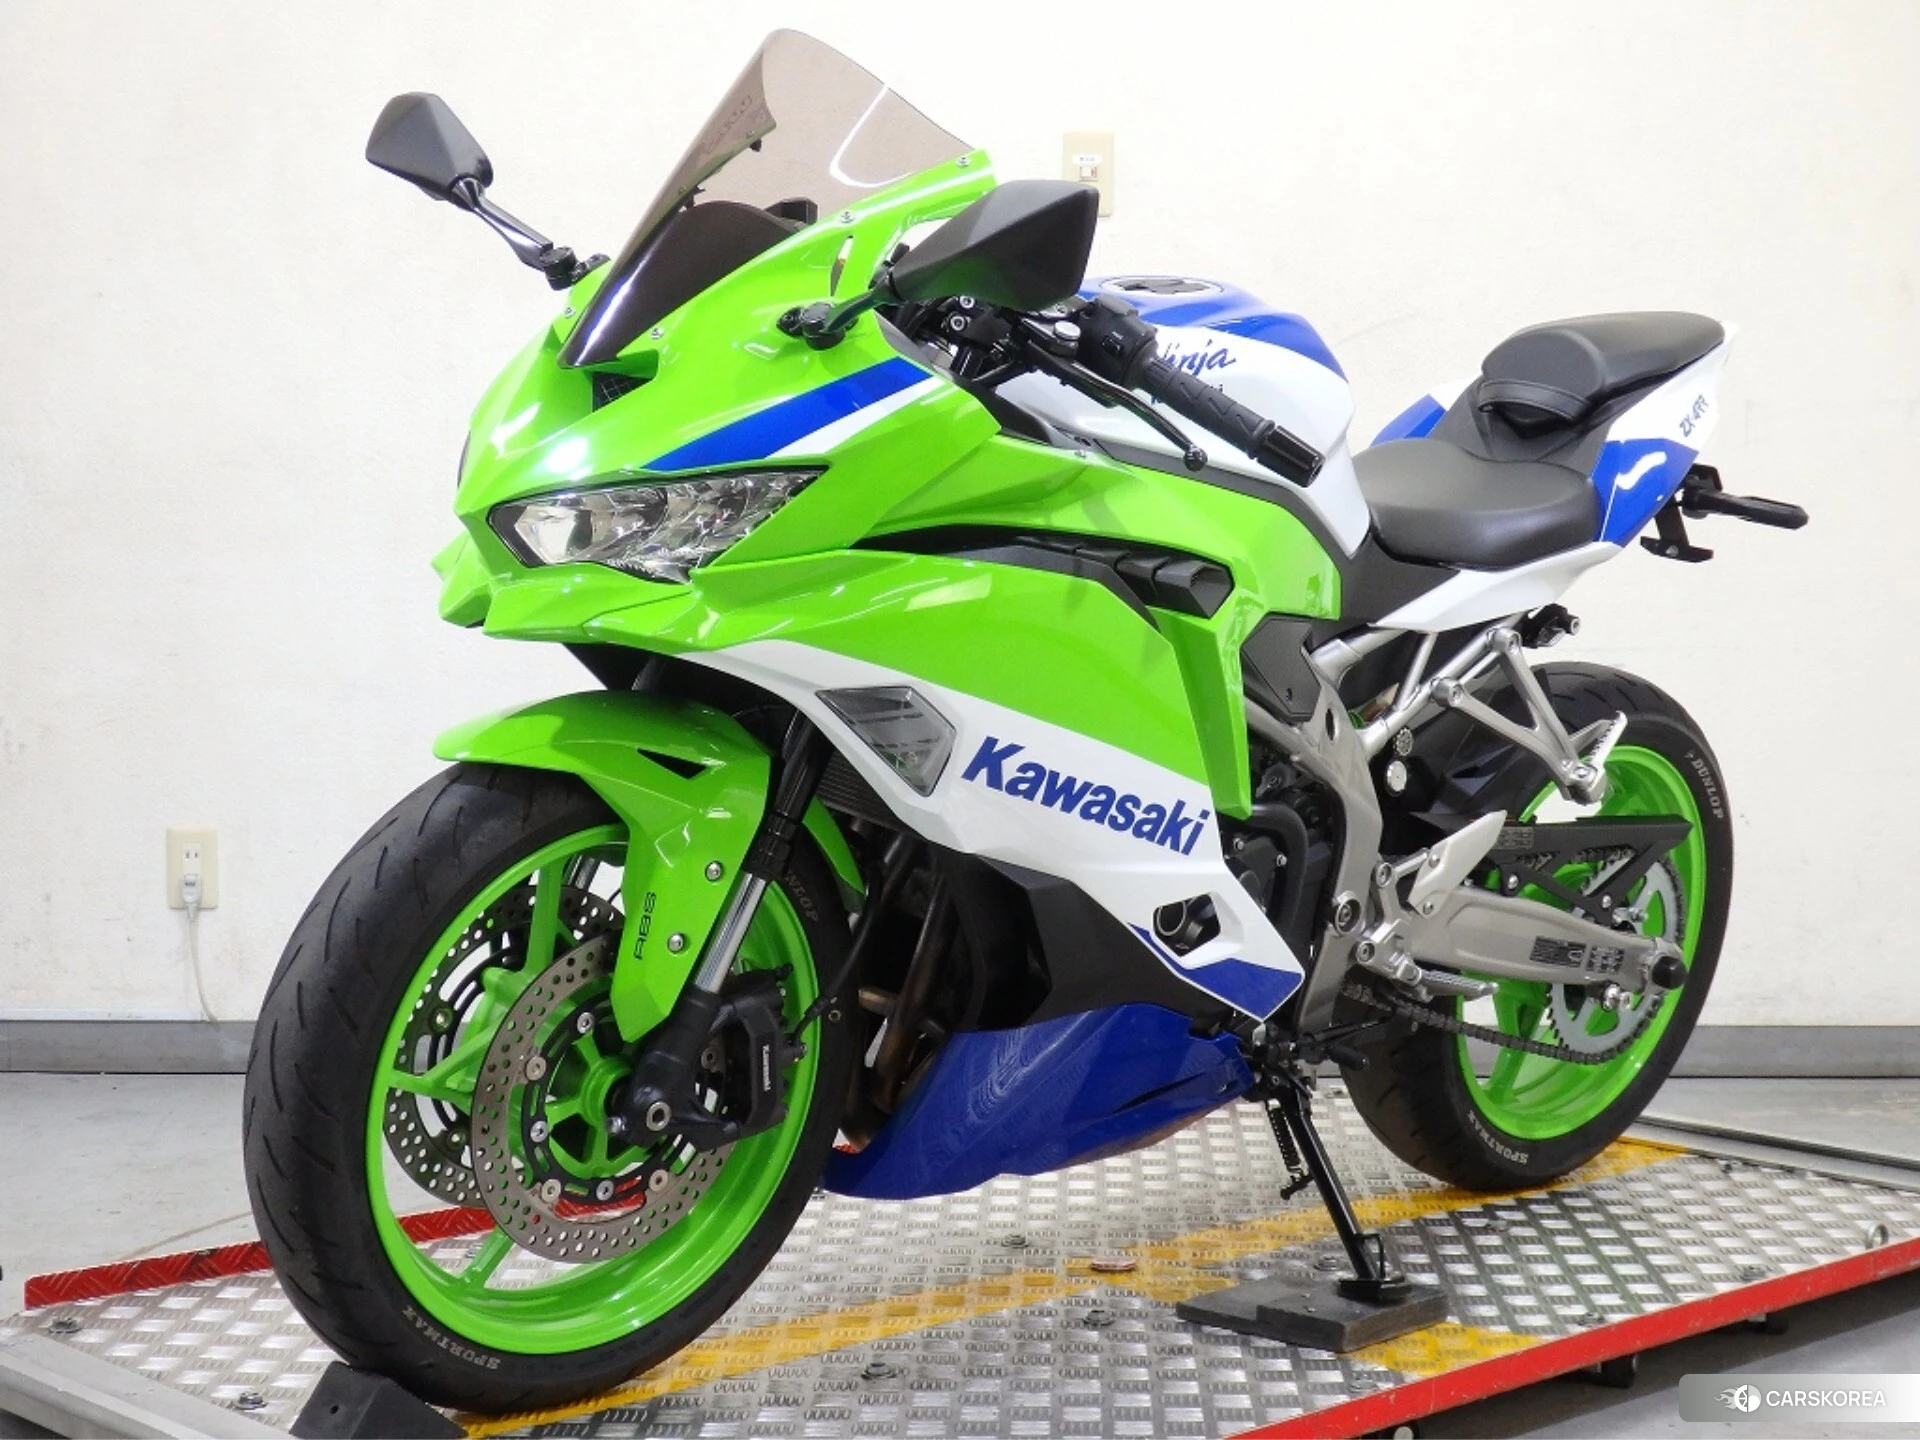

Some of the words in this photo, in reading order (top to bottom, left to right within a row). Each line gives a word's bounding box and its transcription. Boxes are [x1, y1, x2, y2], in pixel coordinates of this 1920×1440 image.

[961, 736, 1210, 855] Kawasaki
[1691, 758, 1724, 818] DUNLOP
[634, 892, 656, 960] ABS
[1468, 1109, 1529, 1165] SPORTMAX
[402, 1305, 501, 1370] SPORTMAX
